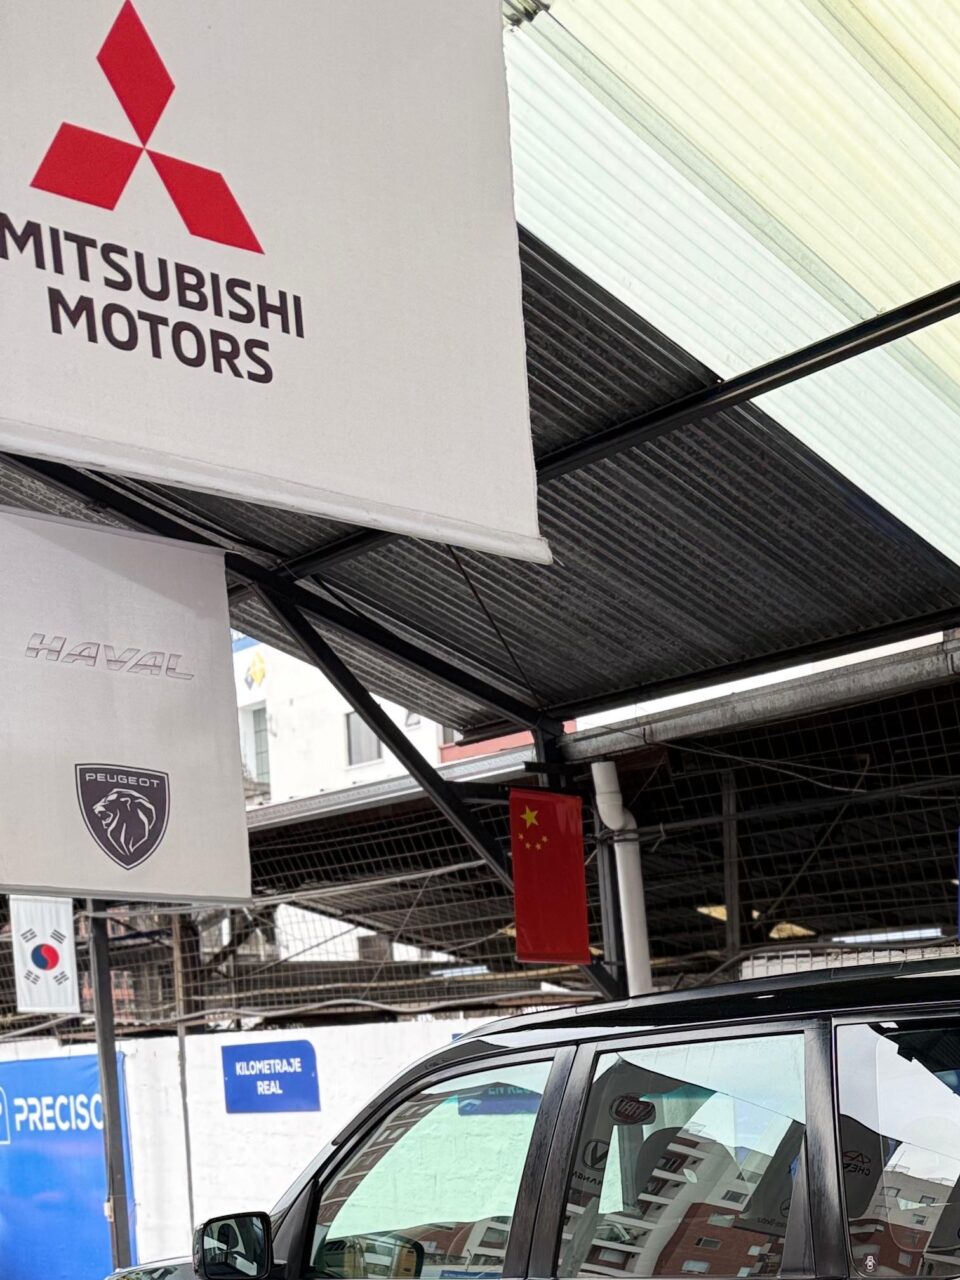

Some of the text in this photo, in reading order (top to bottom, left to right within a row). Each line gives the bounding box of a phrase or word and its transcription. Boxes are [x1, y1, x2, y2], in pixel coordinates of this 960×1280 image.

[0, 212, 305, 339] MITSUBISHI
[47, 286, 274, 385] MOTORS
[24, 632, 195, 681] HAVAL
[85, 772, 161, 788] PEUGEOT
[235, 1057, 302, 1076] KILOMETRAJE
[256, 1080, 284, 1096] REAL
